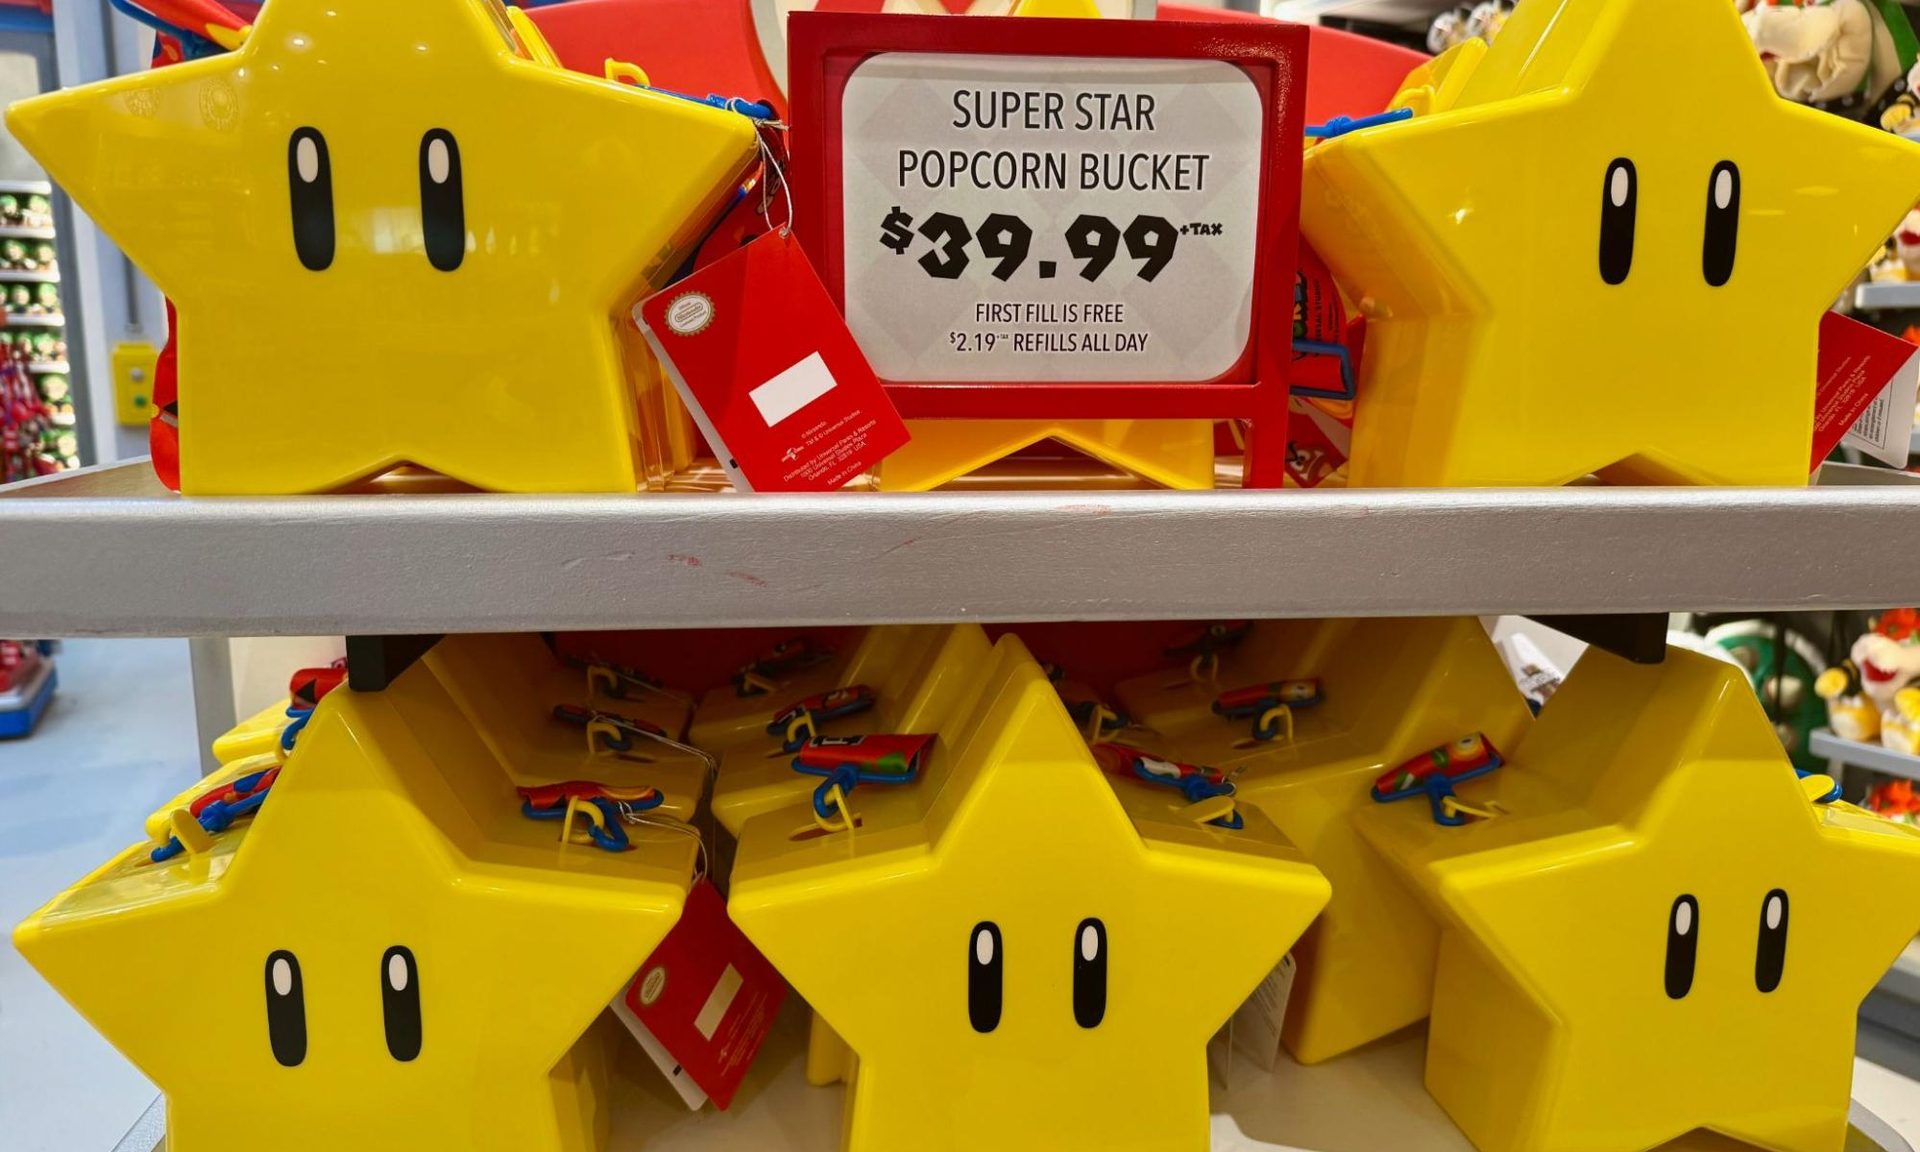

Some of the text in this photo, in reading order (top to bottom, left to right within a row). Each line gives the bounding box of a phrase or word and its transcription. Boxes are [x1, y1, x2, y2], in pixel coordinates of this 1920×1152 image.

[953, 90, 1155, 131] SUPER STAR
[899, 150, 1210, 191] POPCORN BUCKET
[976, 303, 1123, 322] FIRST FILL IS FREE
[949, 331, 996, 351] $2.19
[1014, 333, 1077, 351] REFILLS
[1081, 333, 1110, 351] ALL
[1115, 333, 1148, 351] DAY
